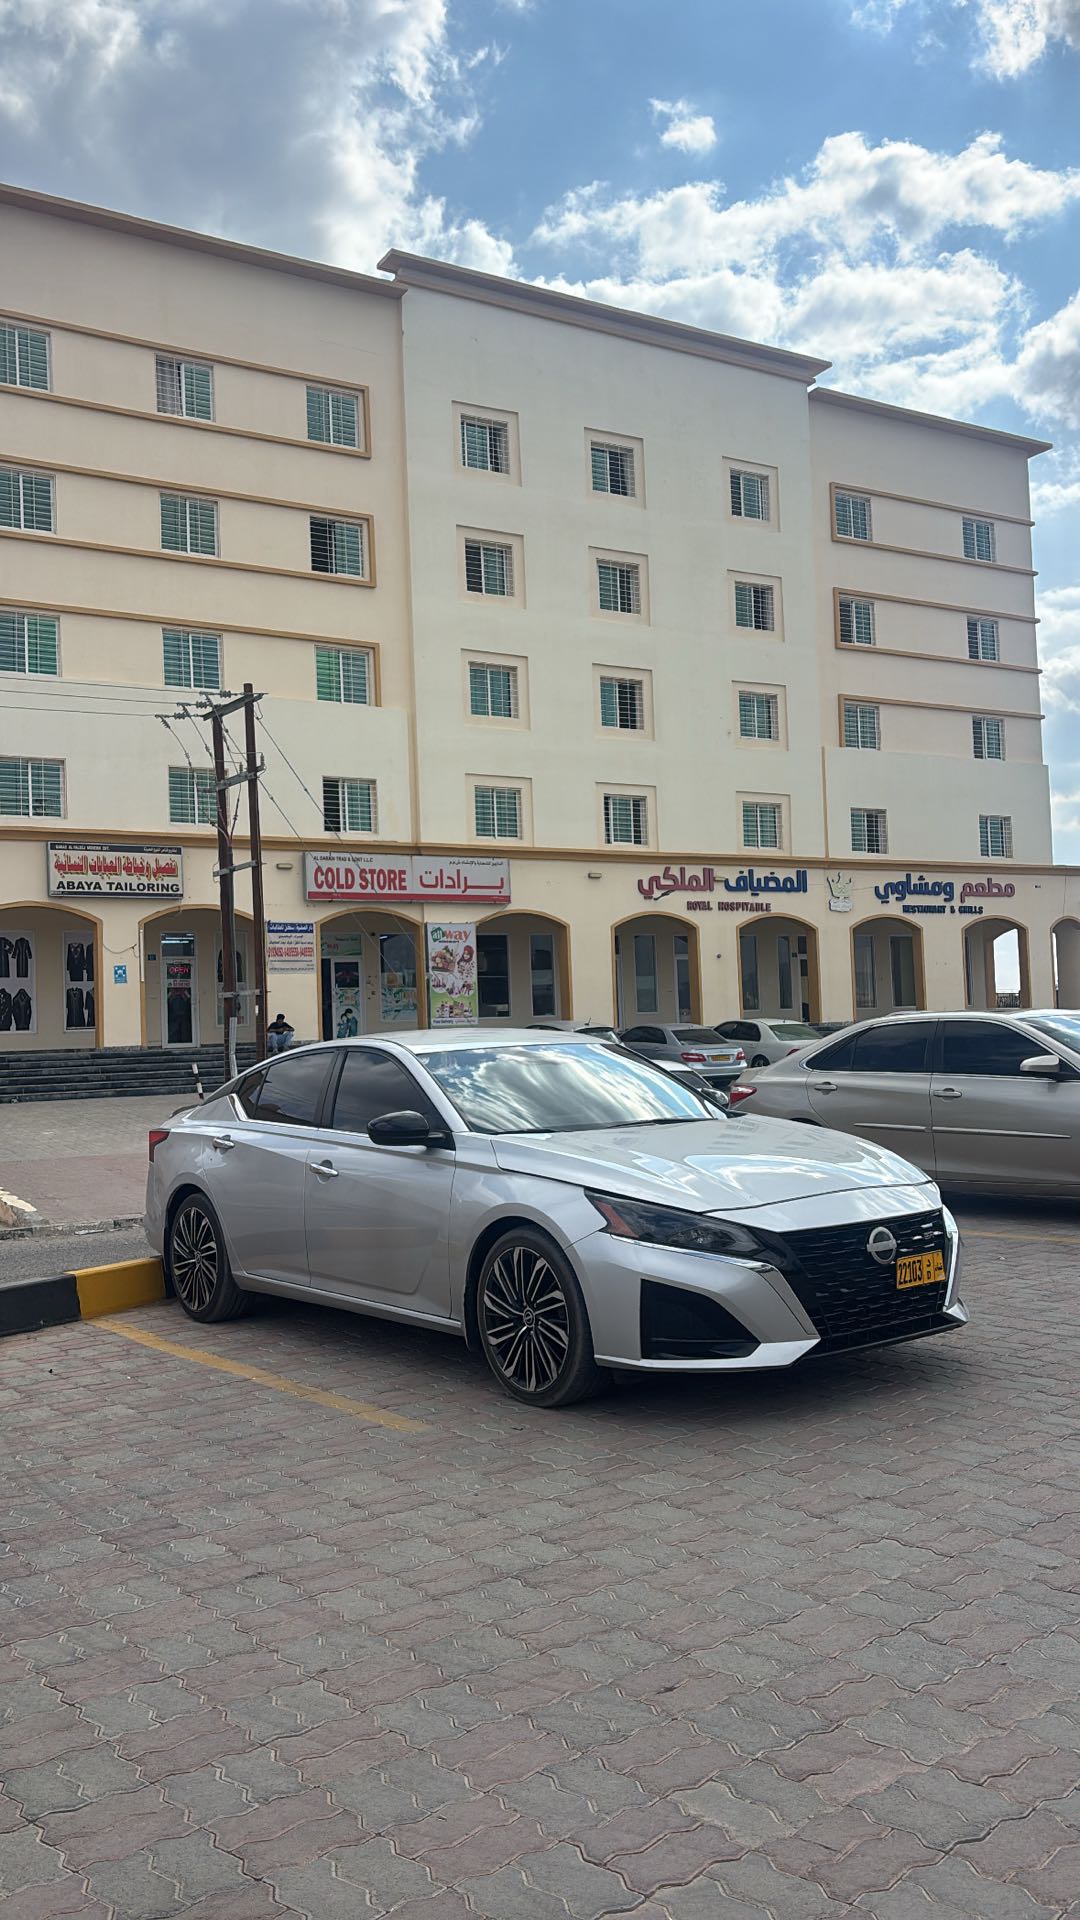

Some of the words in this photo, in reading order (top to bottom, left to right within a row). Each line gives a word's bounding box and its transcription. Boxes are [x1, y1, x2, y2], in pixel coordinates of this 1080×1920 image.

[54, 853, 88, 879] النسائية
[89, 855, 122, 880] العبايات
[152, 857, 178, 881] تفصيل
[314, 866, 355, 890] COLD
[359, 868, 407, 891] STORE
[56, 881, 102, 891] ABAYA
[106, 882, 180, 892] TAILORING
[419, 868, 505, 894] برادات
[637, 866, 715, 900] الملكي
[724, 868, 808, 897] المضياف
[874, 873, 955, 904] ومشاوي
[960, 878, 1016, 904] مطعم
[687, 901, 713, 911] ROYAL
[718, 902, 772, 912] HOSPITABLE
[169, 966, 189, 974] OPEN
[898, 1259, 923, 1286] 22103
